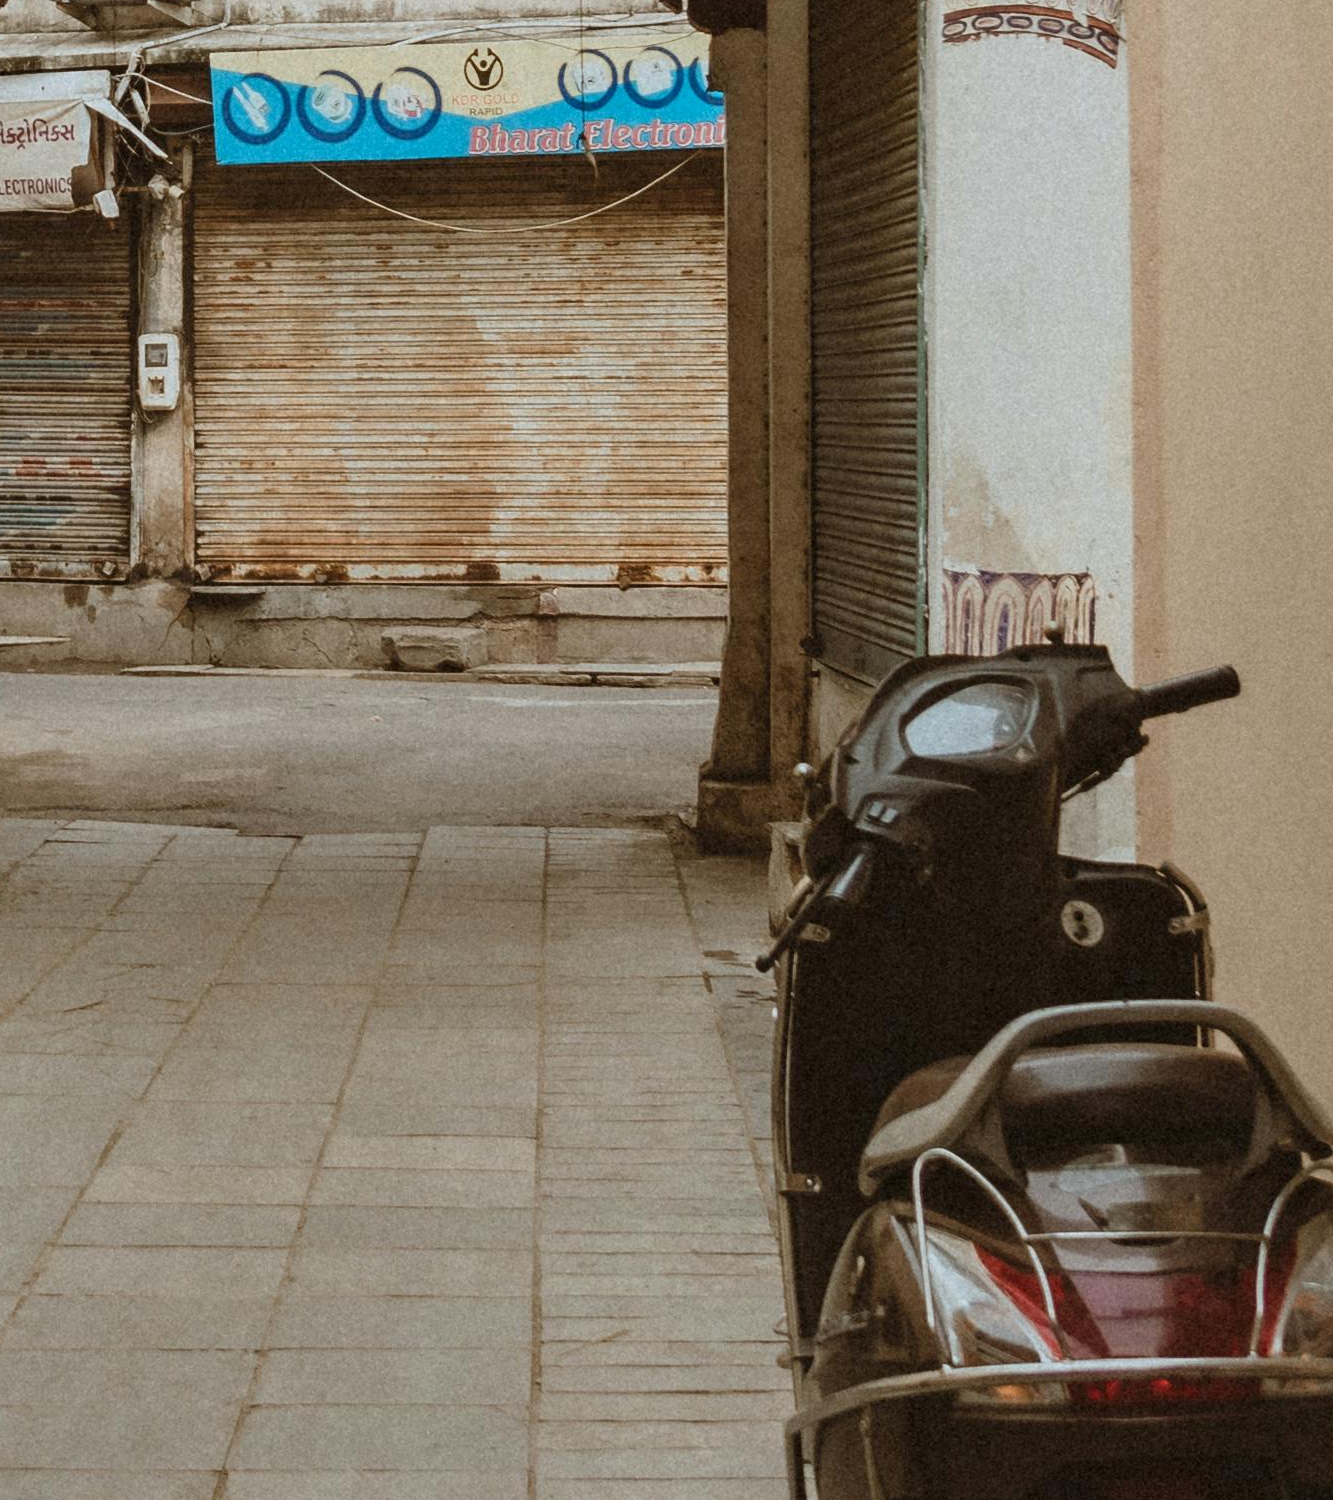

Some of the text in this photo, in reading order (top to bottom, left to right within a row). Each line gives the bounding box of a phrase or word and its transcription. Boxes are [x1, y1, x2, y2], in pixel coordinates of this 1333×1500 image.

[483, 92, 520, 105] GOLD
[469, 107, 503, 116] RAPID
[468, 121, 576, 155] Bharat
